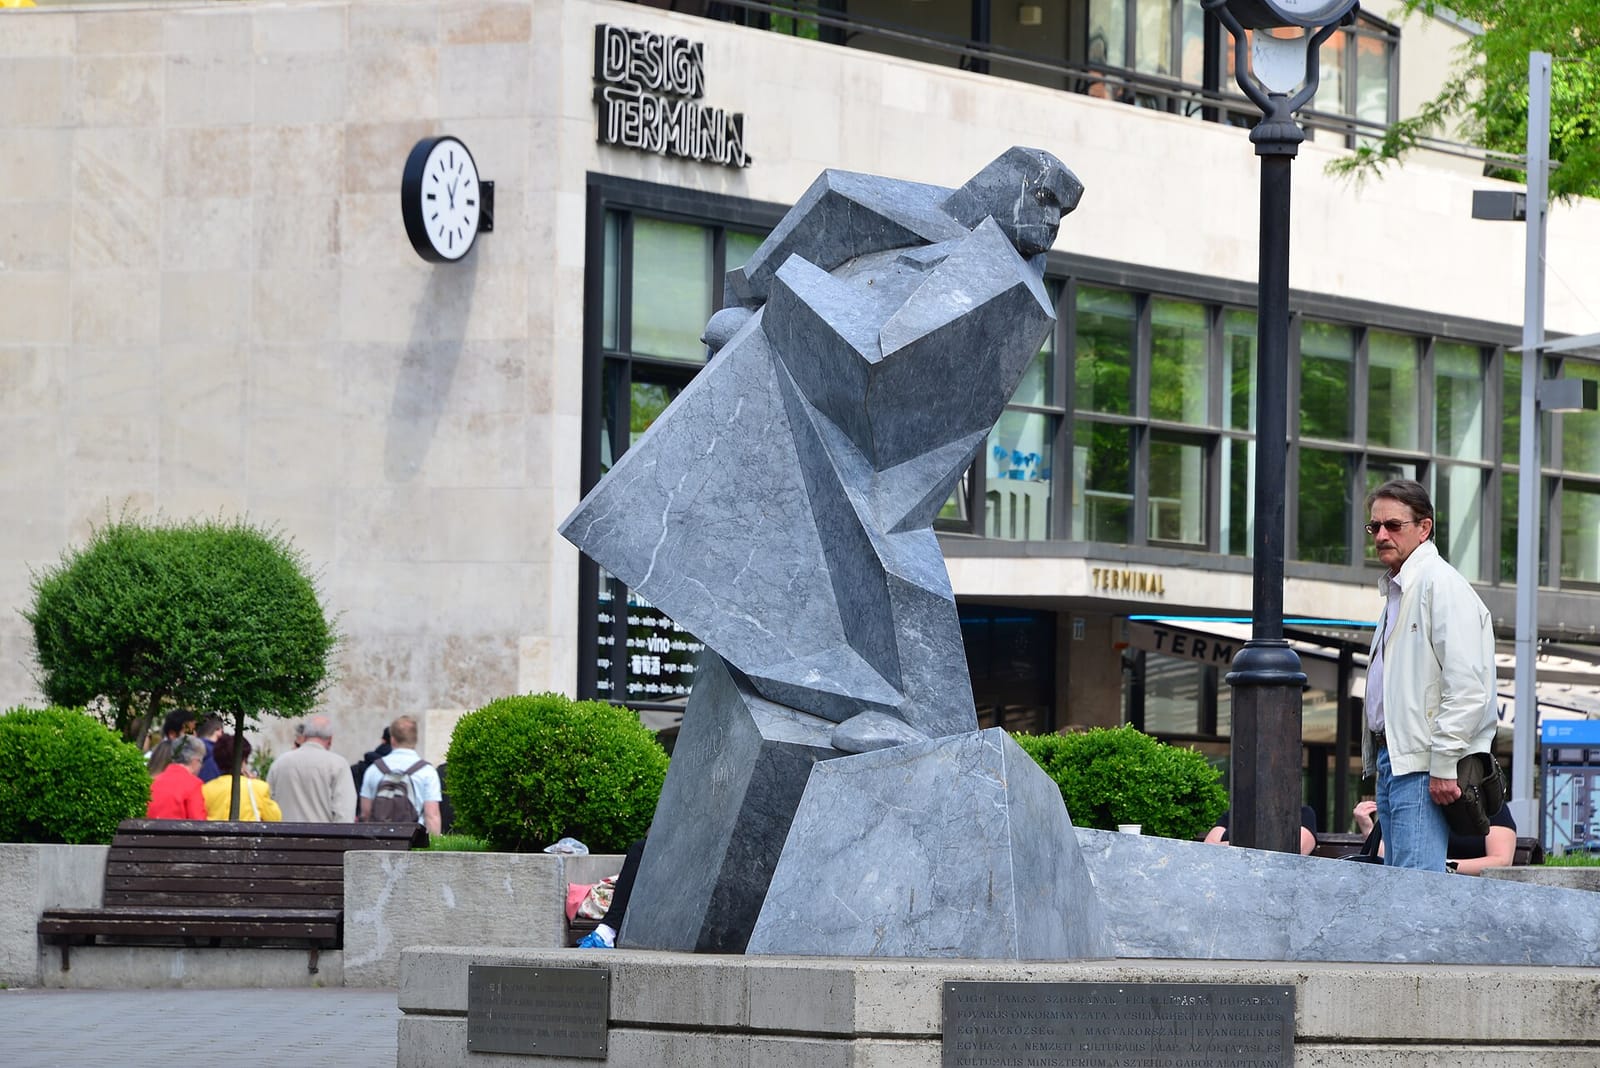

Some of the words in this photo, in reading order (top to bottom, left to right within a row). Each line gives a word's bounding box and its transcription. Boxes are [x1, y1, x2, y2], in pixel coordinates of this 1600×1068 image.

[598, 24, 709, 98] DESIGN
[1092, 568, 1165, 595] TERMINAL
[647, 632, 670, 653] vino
[1153, 630, 1232, 664] TERM
